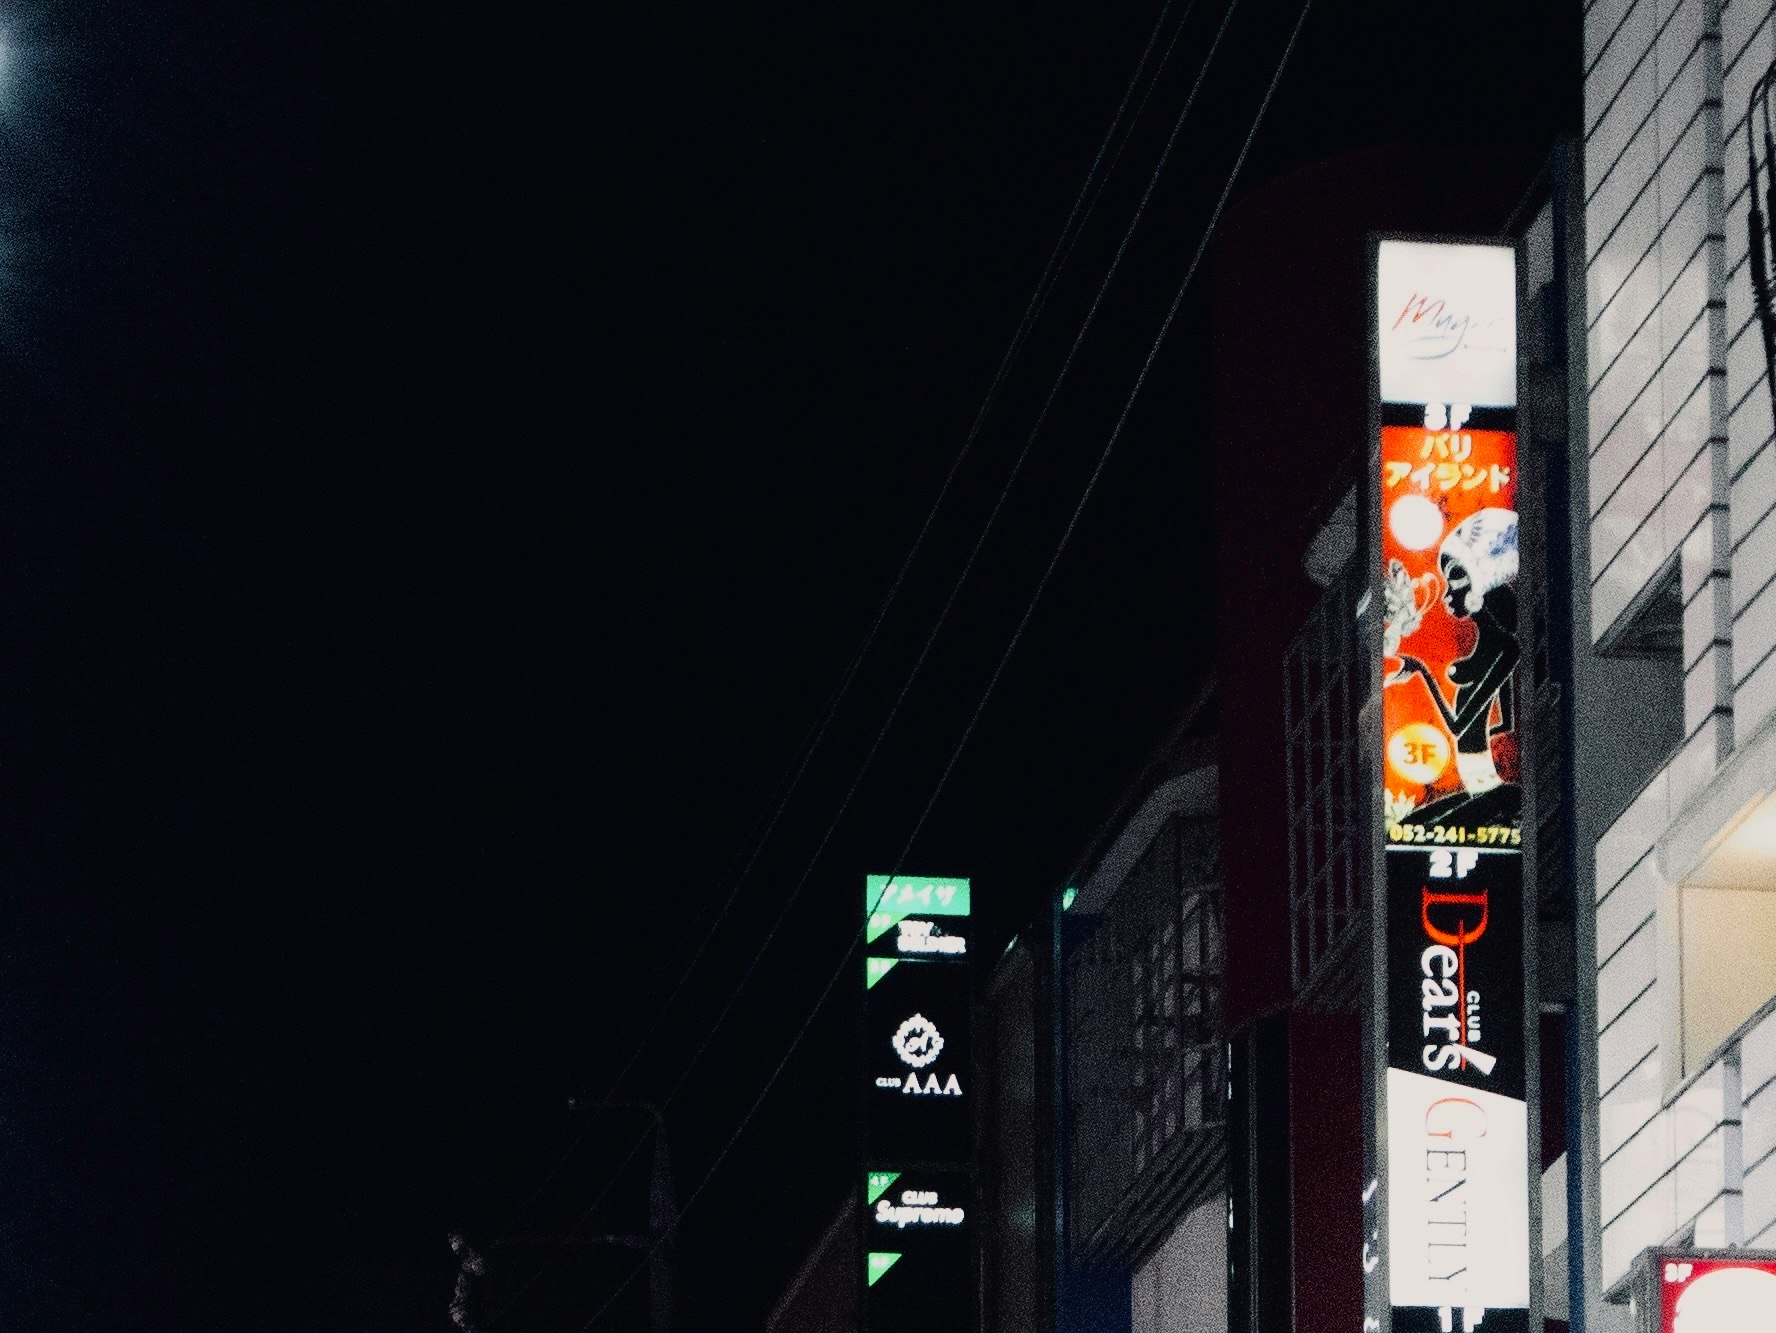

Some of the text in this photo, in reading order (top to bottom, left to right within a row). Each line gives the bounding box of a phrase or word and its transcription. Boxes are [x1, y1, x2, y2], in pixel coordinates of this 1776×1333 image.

[1387, 462, 1512, 493] アイランド
[1403, 740, 1436, 766] 3F
[1389, 824, 1522, 845] 052-241-5775
[1464, 991, 1482, 1042] CLUB
[903, 1072, 962, 1095] AAA
